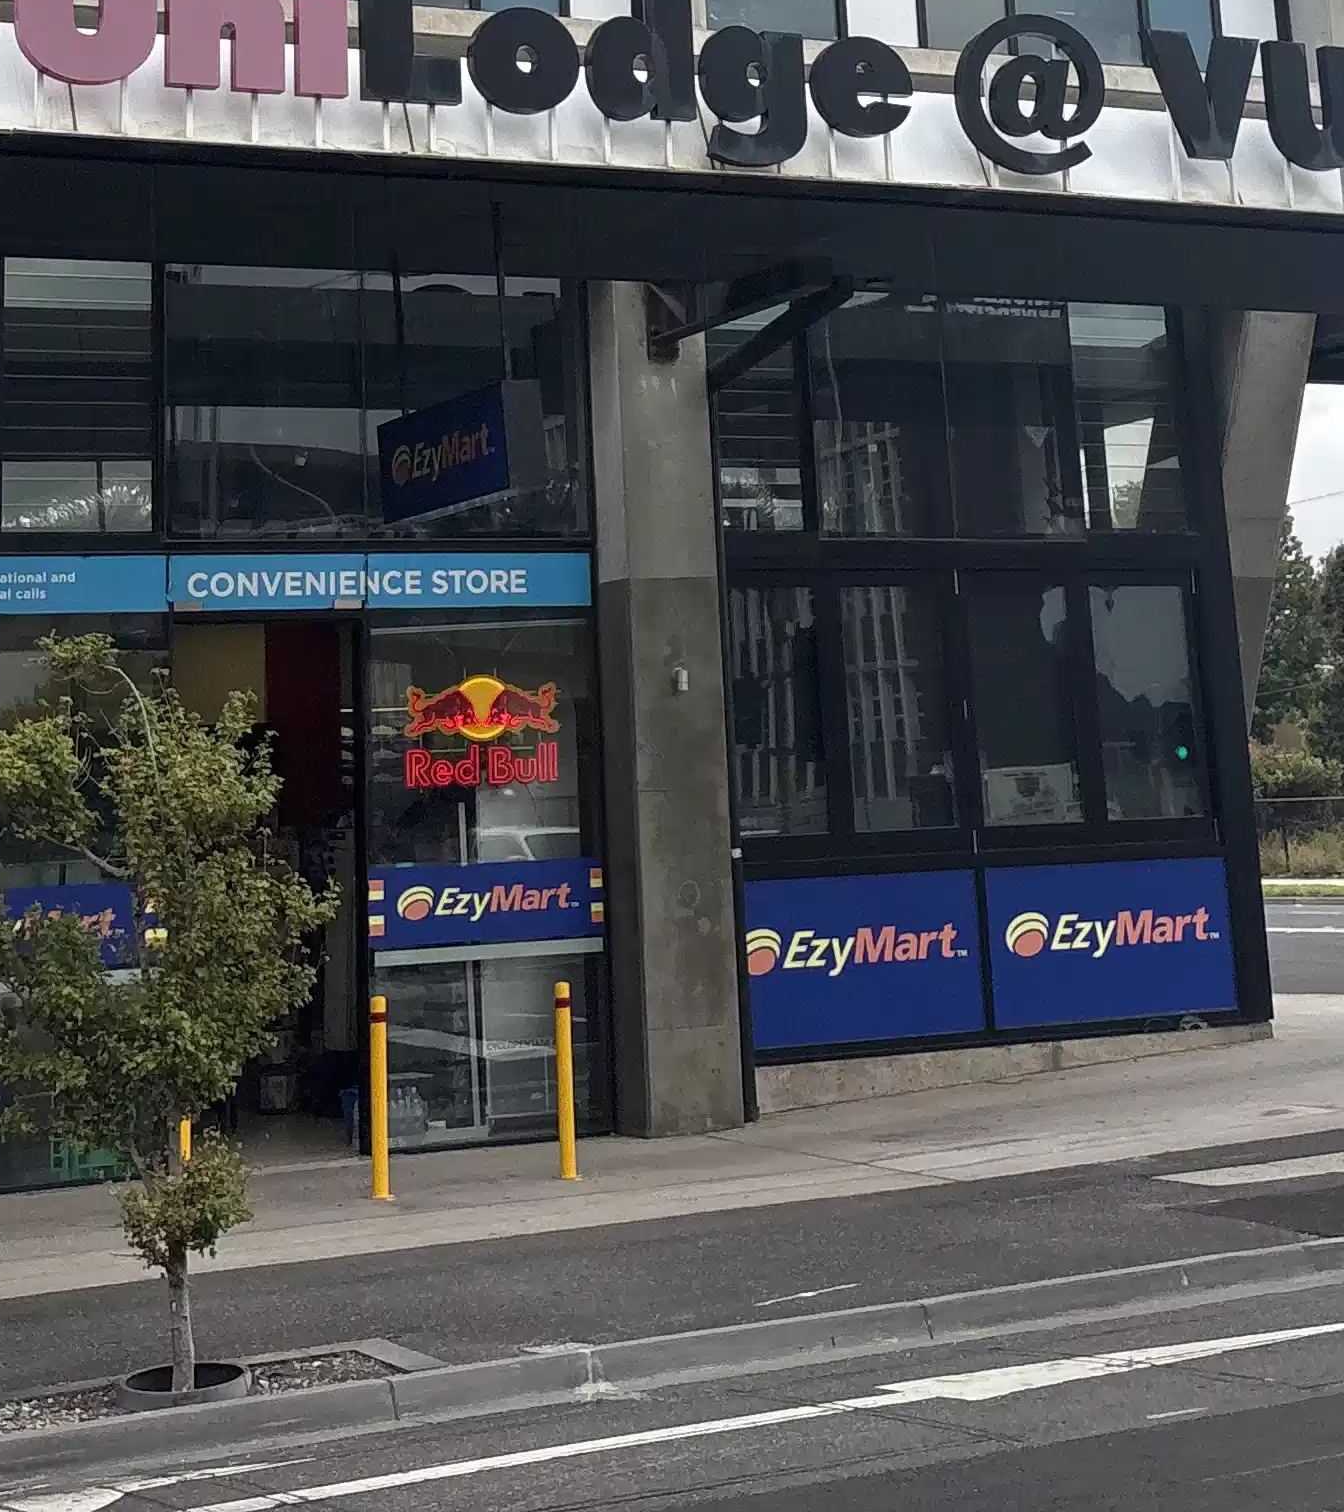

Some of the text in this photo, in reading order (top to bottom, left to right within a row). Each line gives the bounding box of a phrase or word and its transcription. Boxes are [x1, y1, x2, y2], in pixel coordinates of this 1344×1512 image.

[954, 14, 1105, 175] @
[15, 587, 47, 600] calls
[50, 571, 76, 583] and
[187, 569, 528, 598] CONVENIENCE STORE
[405, 741, 560, 789] Red Bull
[434, 882, 571, 922] EzyMart
[782, 922, 957, 977] EzyMart
[1050, 906, 1209, 959] EzyMart
